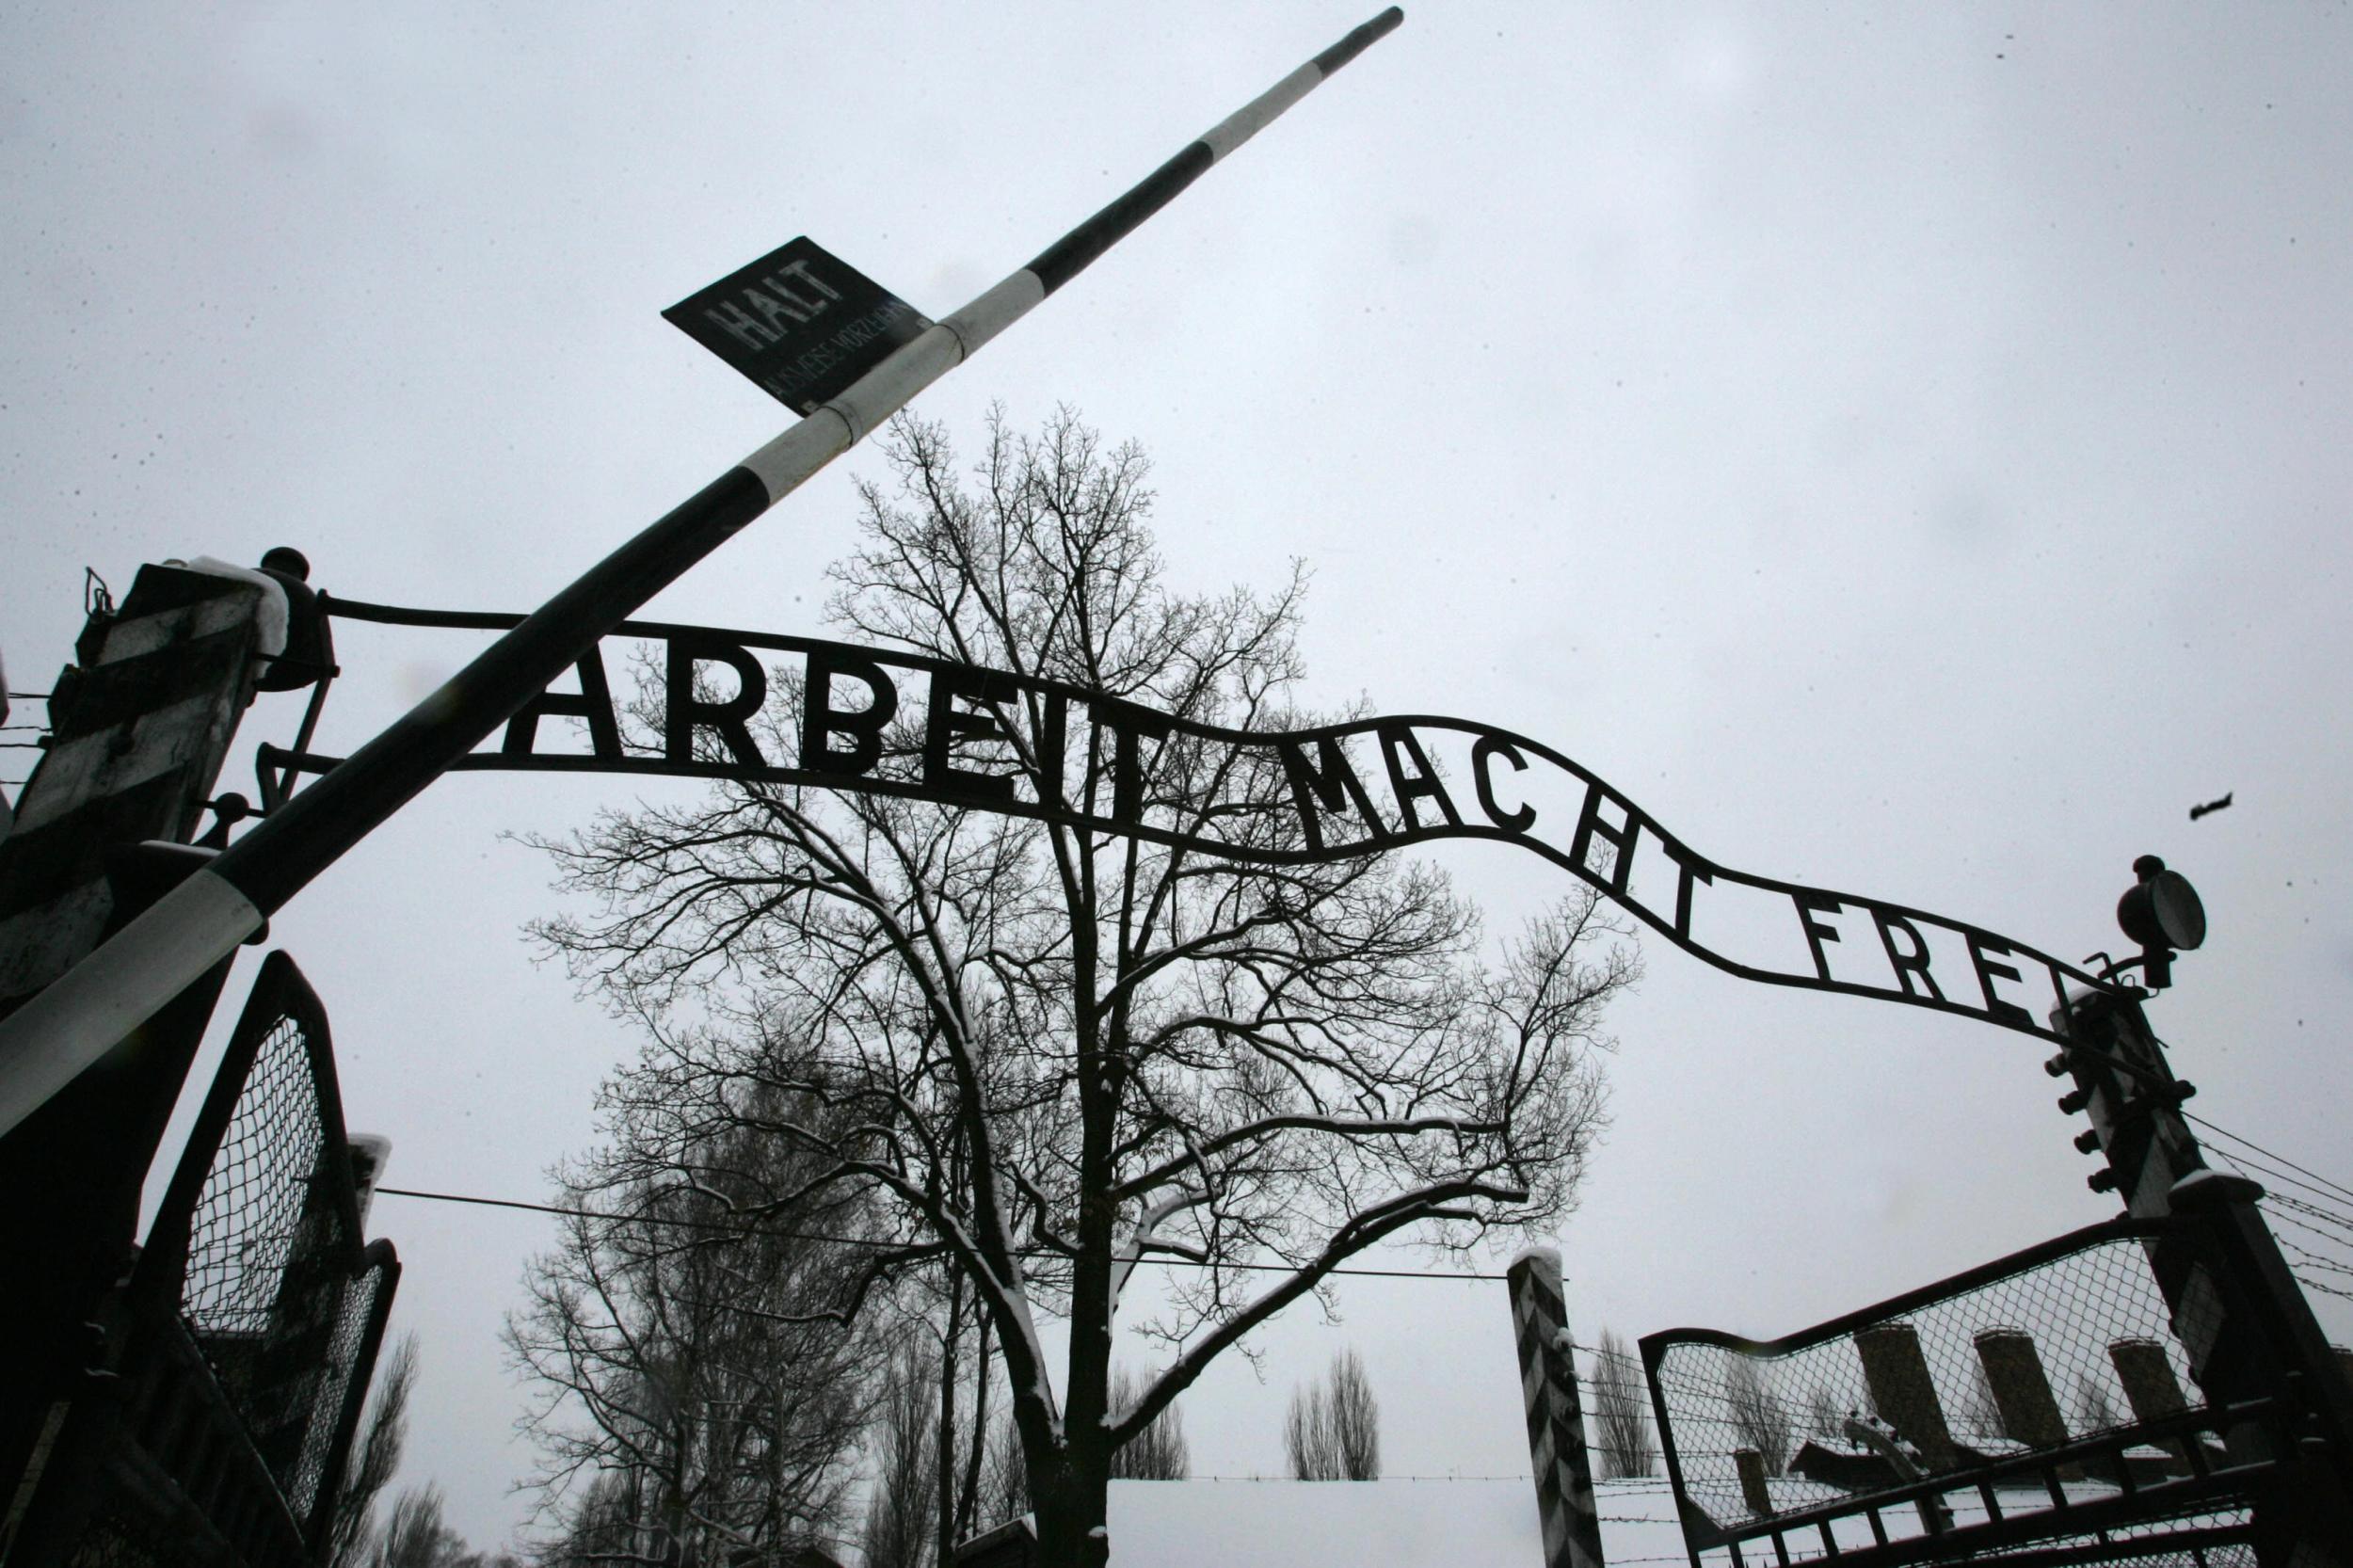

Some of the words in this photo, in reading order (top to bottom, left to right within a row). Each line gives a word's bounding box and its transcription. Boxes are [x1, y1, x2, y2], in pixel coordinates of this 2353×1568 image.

[703, 259, 843, 351] HALT
[501, 629, 1171, 824] ARBEIT
[1277, 724, 1712, 941] MACHT
[1793, 893, 2073, 1041] FREI
